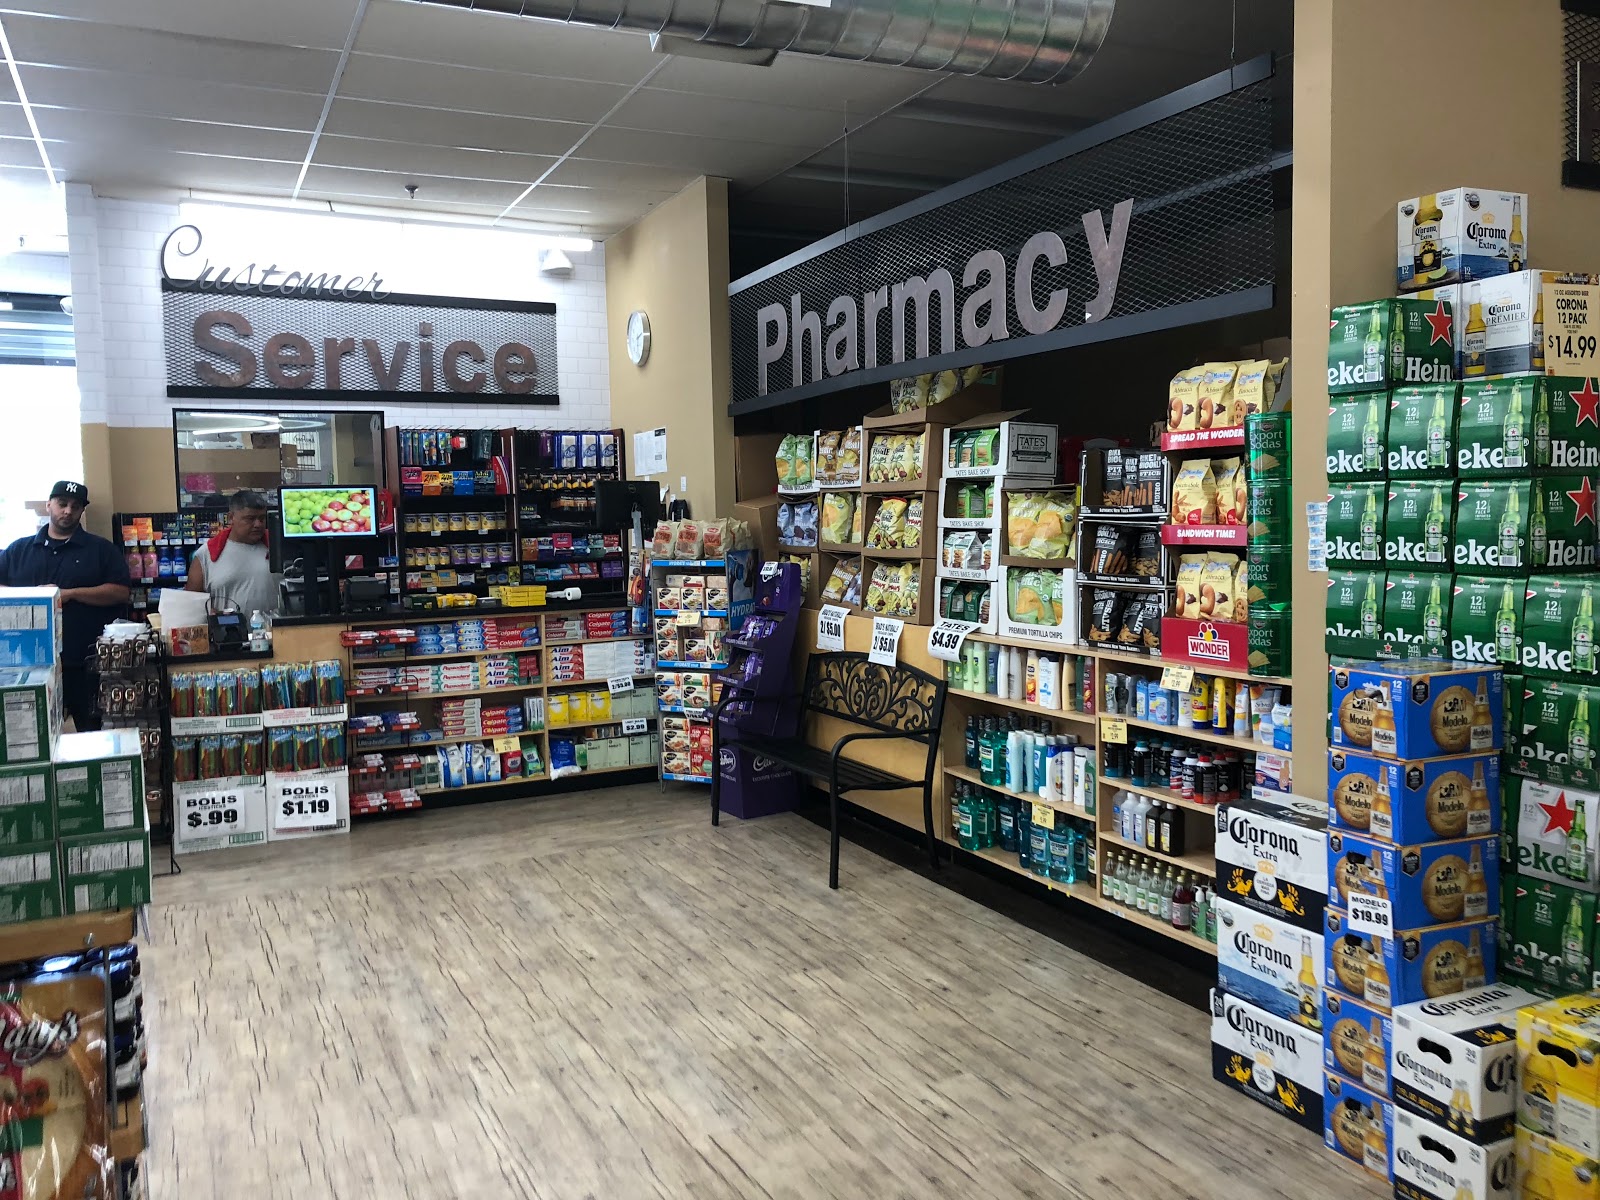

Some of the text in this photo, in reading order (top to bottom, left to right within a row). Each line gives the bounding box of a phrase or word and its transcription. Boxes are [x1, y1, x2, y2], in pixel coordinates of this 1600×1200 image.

[1415, 225, 1437, 236] Corona
[1467, 222, 1507, 242] Corona
[1479, 239, 1496, 250] Extra
[160, 224, 392, 299] Customer
[1402, 266, 1409, 274] 12
[757, 197, 1134, 396] Pharmacy
[1488, 303, 1521, 316] Corona
[1556, 298, 1588, 310] CORONA
[1409, 312, 1419, 321] 12
[1486, 312, 1526, 325] PREMIER
[1558, 313, 1588, 324] 12 PACK
[1345, 325, 1354, 334] 12
[193, 309, 538, 394] Service
[1548, 335, 1597, 359] $14.99
[1554, 391, 1562, 401] 12
[1407, 407, 1416, 416] 12
[1479, 403, 1489, 413] 12
[1343, 414, 1352, 422] 12
[1020, 437, 1046, 447] TATE'S
[1170, 433, 1195, 442] SPREAD
[1197, 432, 1209, 440] THE
[1250, 440, 1281, 449] Sodas
[1549, 491, 1559, 501] 12
[1341, 501, 1349, 509] 12
[1404, 500, 1414, 509] 12
[1476, 500, 1487, 509] 12
[1177, 530, 1235, 538] SANDWICH TIME!
[1341, 588, 1350, 596] 12
[1402, 591, 1412, 599] 12
[1471, 596, 1482, 605] 12
[1545, 600, 1557, 611] 12
[827, 622, 841, 638] $5.00
[940, 621, 971, 631] TATES
[1008, 626, 1063, 639] PREMIUM TORTILLA CHIPS
[879, 636, 895, 653] $5.00
[931, 630, 960, 650] $4.39
[1190, 640, 1228, 656] WONDER
[1376, 651, 1401, 659] Heineken
[1543, 702, 1554, 712] 12
[1350, 713, 1372, 726] Modelo
[1442, 715, 1468, 727] Modelo
[1374, 730, 1395, 741] Modelo
[1489, 757, 1498, 765] 12
[1389, 766, 1397, 774] 12
[282, 786, 329, 796] BOLIS
[186, 795, 237, 808] BOLIS
[282, 799, 330, 816] $1.19
[1345, 795, 1371, 809] Modelo
[1438, 801, 1464, 813] Modelo
[187, 809, 238, 828] $.99
[1219, 810, 1227, 822] 24
[1230, 816, 1299, 857] Corona
[1253, 845, 1278, 863] Extra
[1383, 851, 1392, 860] 12
[1517, 843, 1567, 876] eke
[1352, 896, 1387, 908] MODELO
[1536, 902, 1548, 913] 12
[1352, 908, 1388, 925] $19.99
[1234, 930, 1293, 970] Corona
[1250, 955, 1278, 979] Extra
[1420, 990, 1512, 1016] Coronita
[1226, 1004, 1298, 1055] Corona
[1250, 1034, 1275, 1056] Extra
[1396, 1050, 1452, 1090] Coronita
[1397, 1147, 1456, 1188] Coronita
